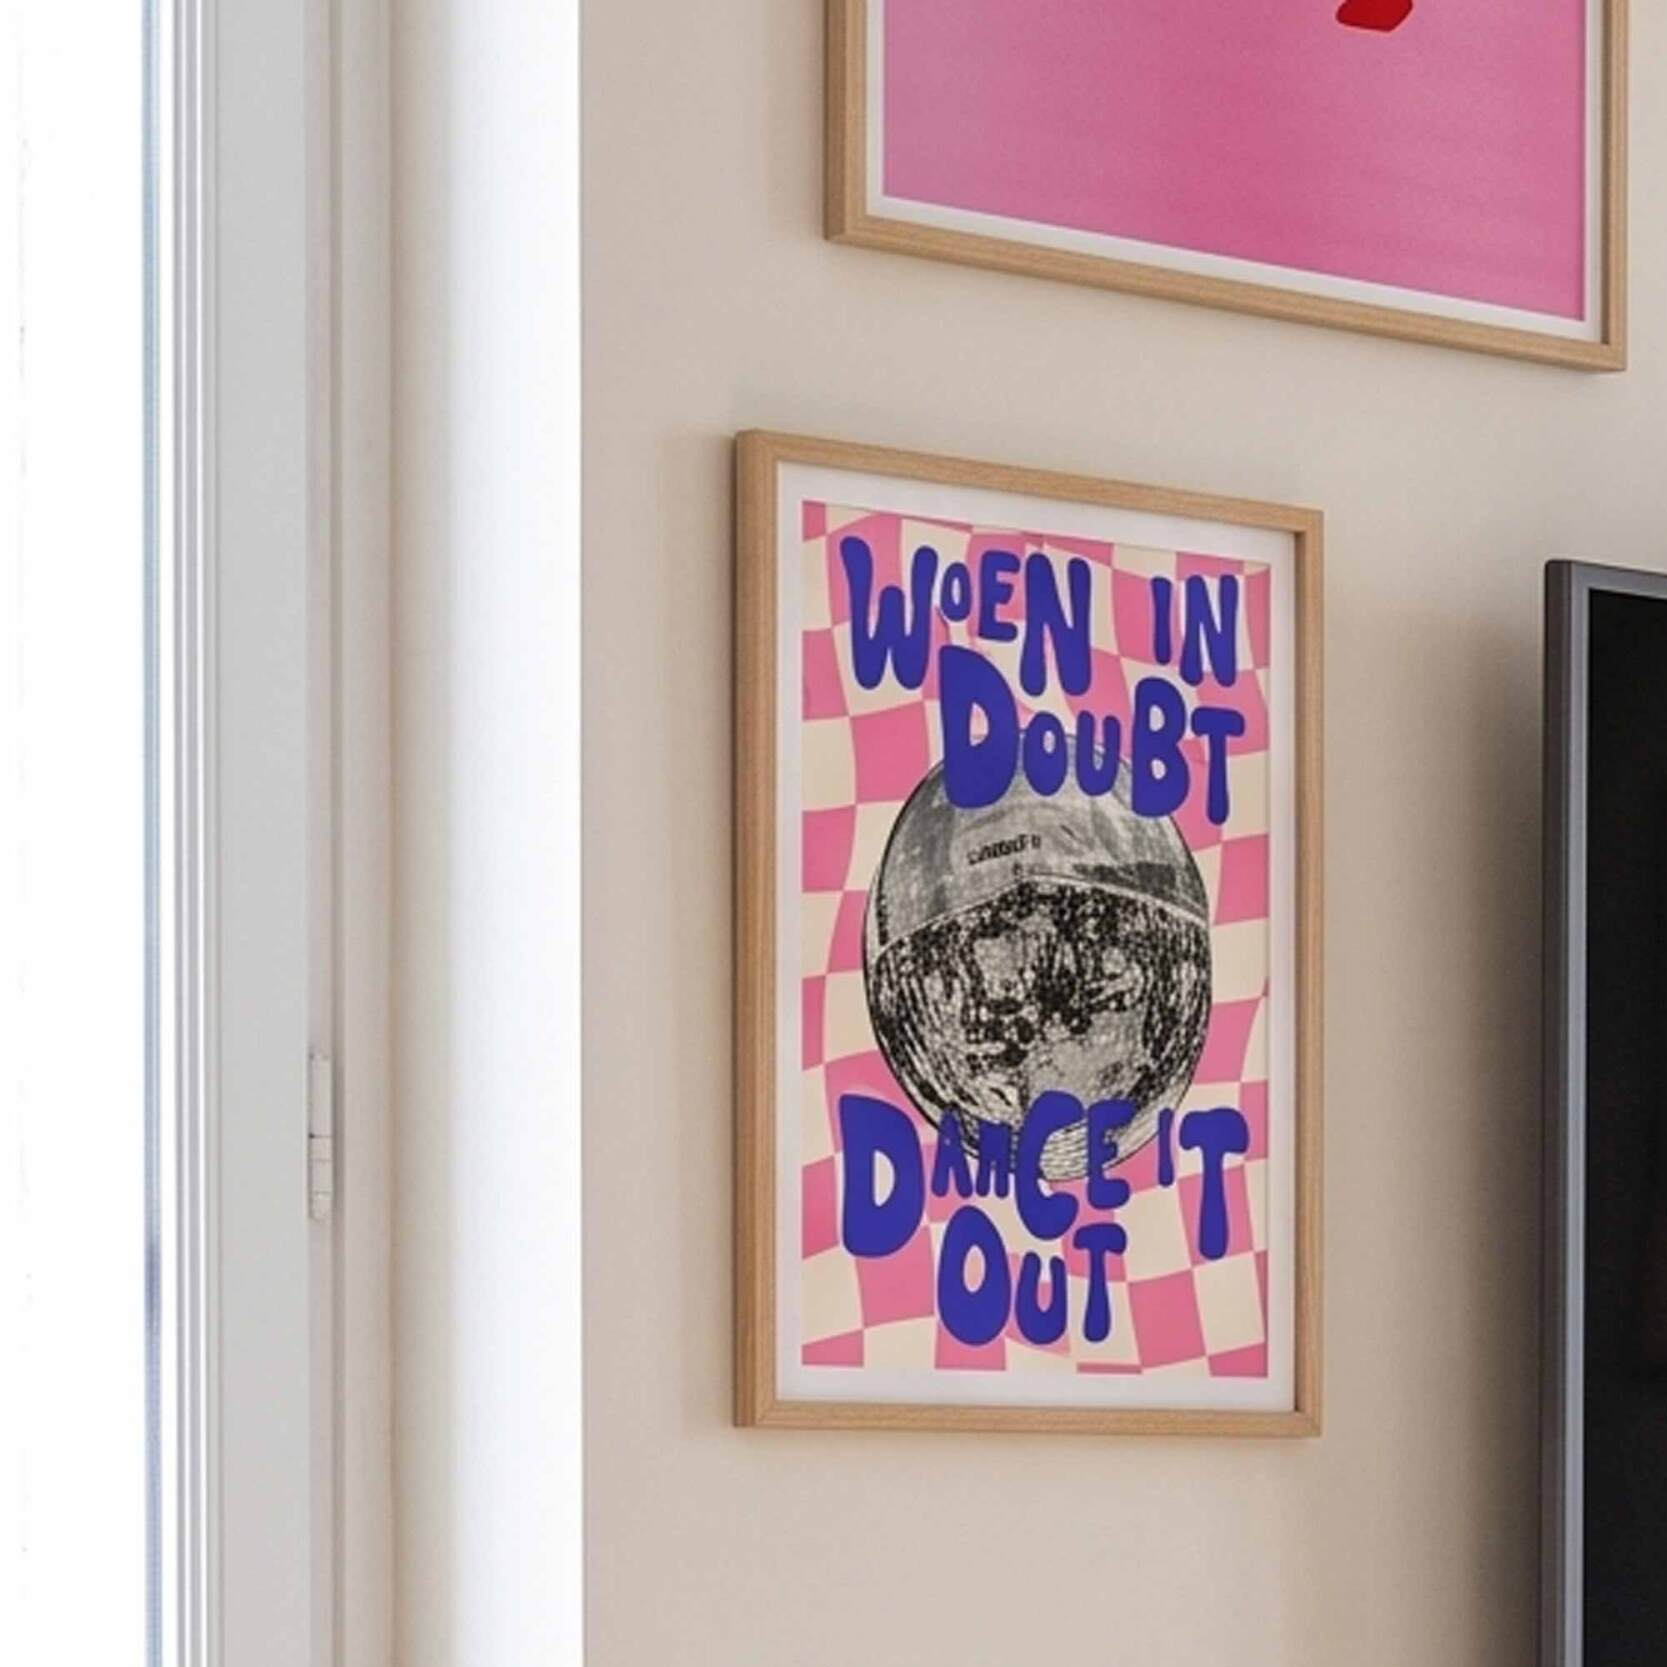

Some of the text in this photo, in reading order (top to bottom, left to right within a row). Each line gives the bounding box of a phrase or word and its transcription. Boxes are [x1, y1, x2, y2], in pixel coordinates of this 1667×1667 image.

[1151, 574, 1239, 687] IN
[938, 645, 1246, 826] DOUBT
[1157, 1107, 1250, 1261] IT
[936, 1204, 1128, 1346] OUT
